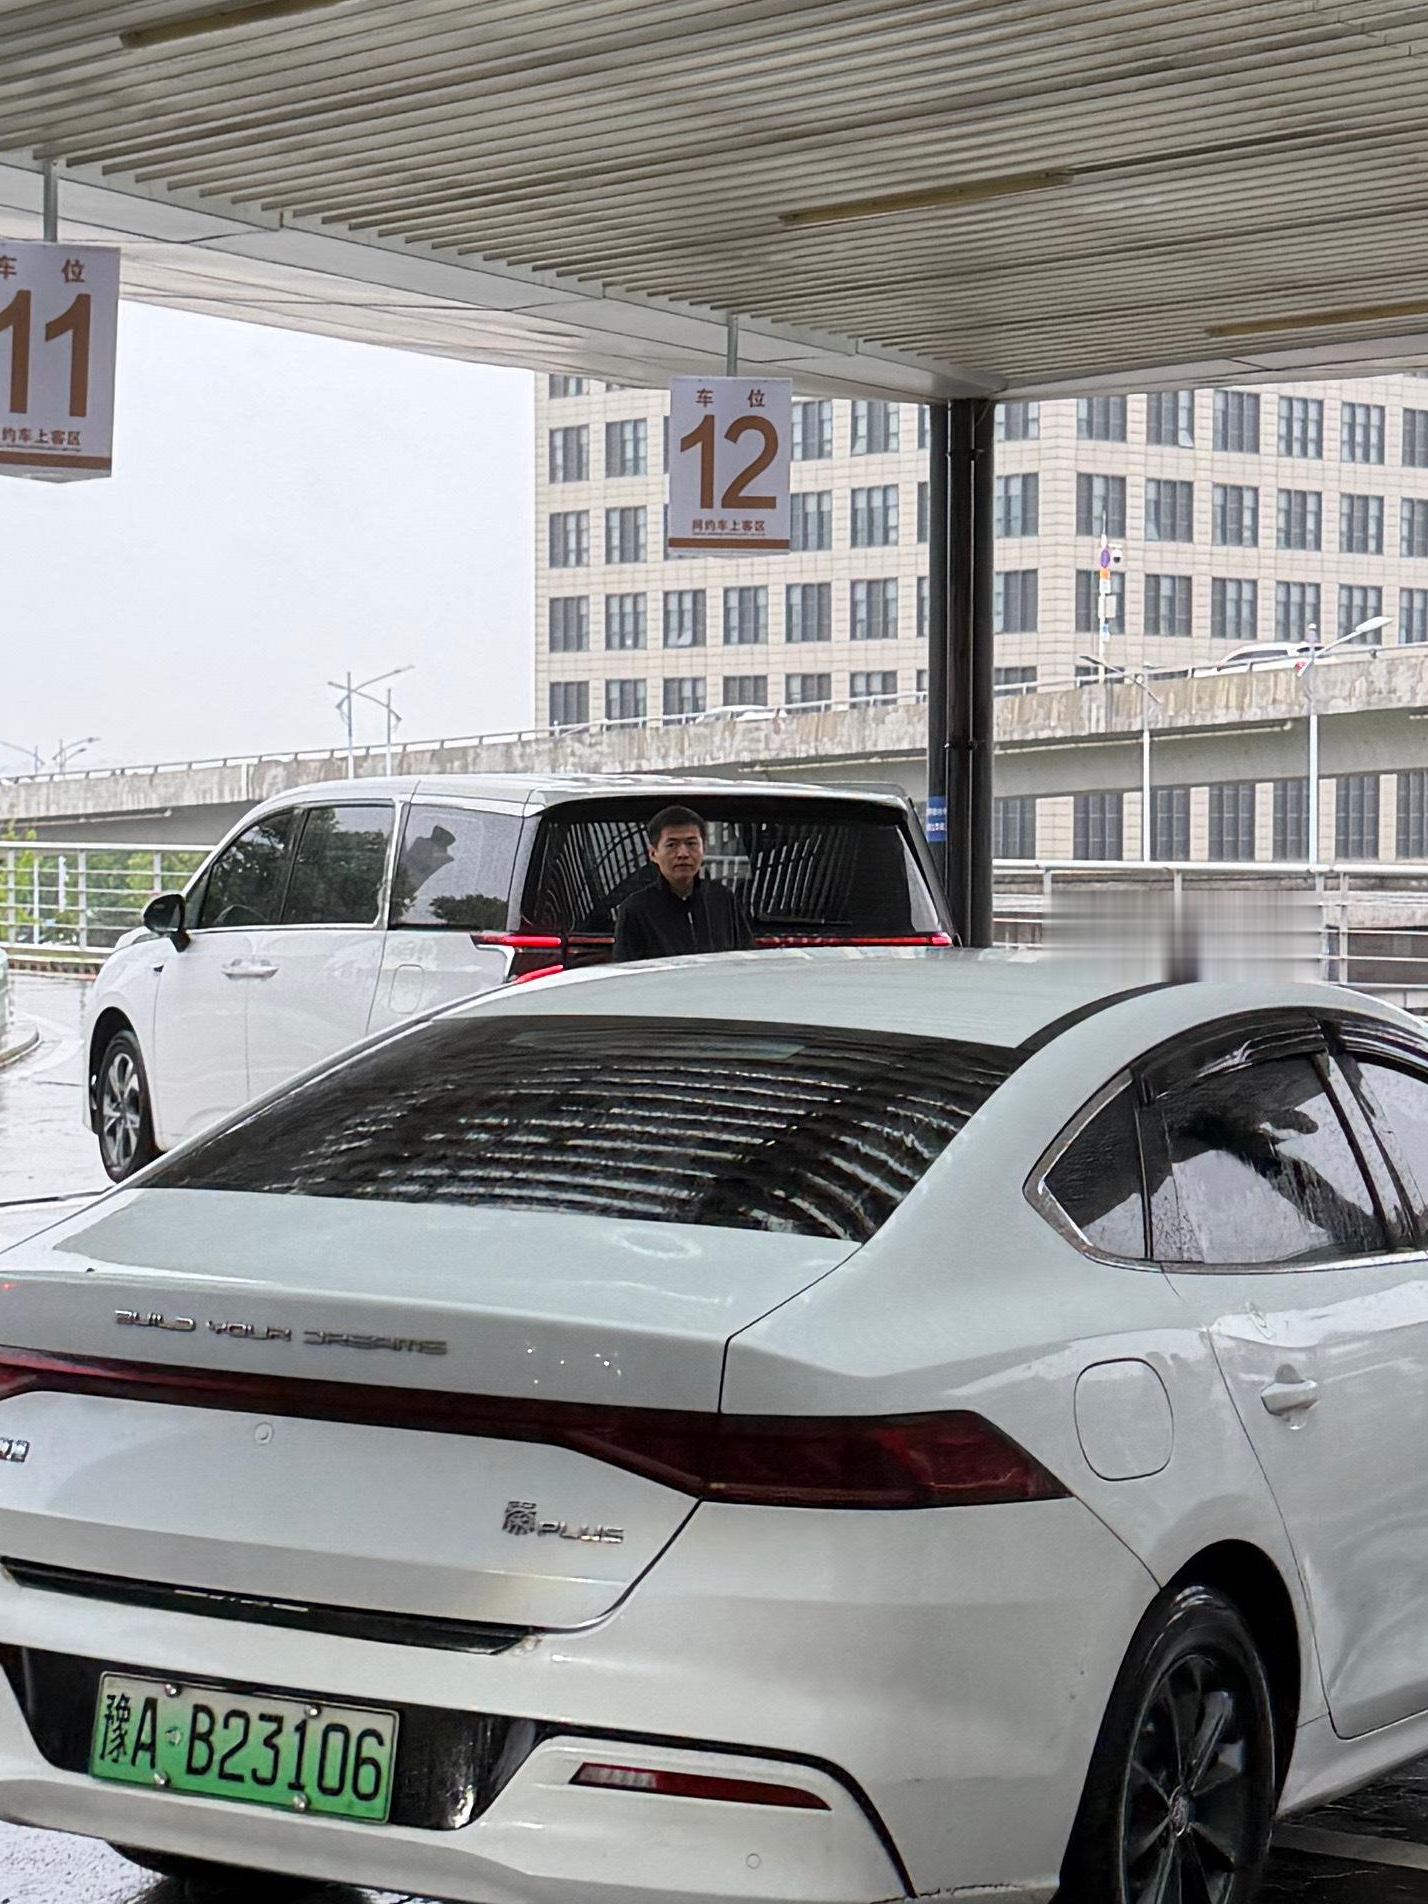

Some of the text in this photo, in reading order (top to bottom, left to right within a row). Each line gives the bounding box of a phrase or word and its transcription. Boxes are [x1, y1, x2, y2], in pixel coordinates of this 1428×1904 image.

[696, 388, 765, 408] 车位
[680, 415, 779, 509] 12
[115, 1309, 197, 1332] BUILD
[206, 1319, 292, 1342] YOUR
